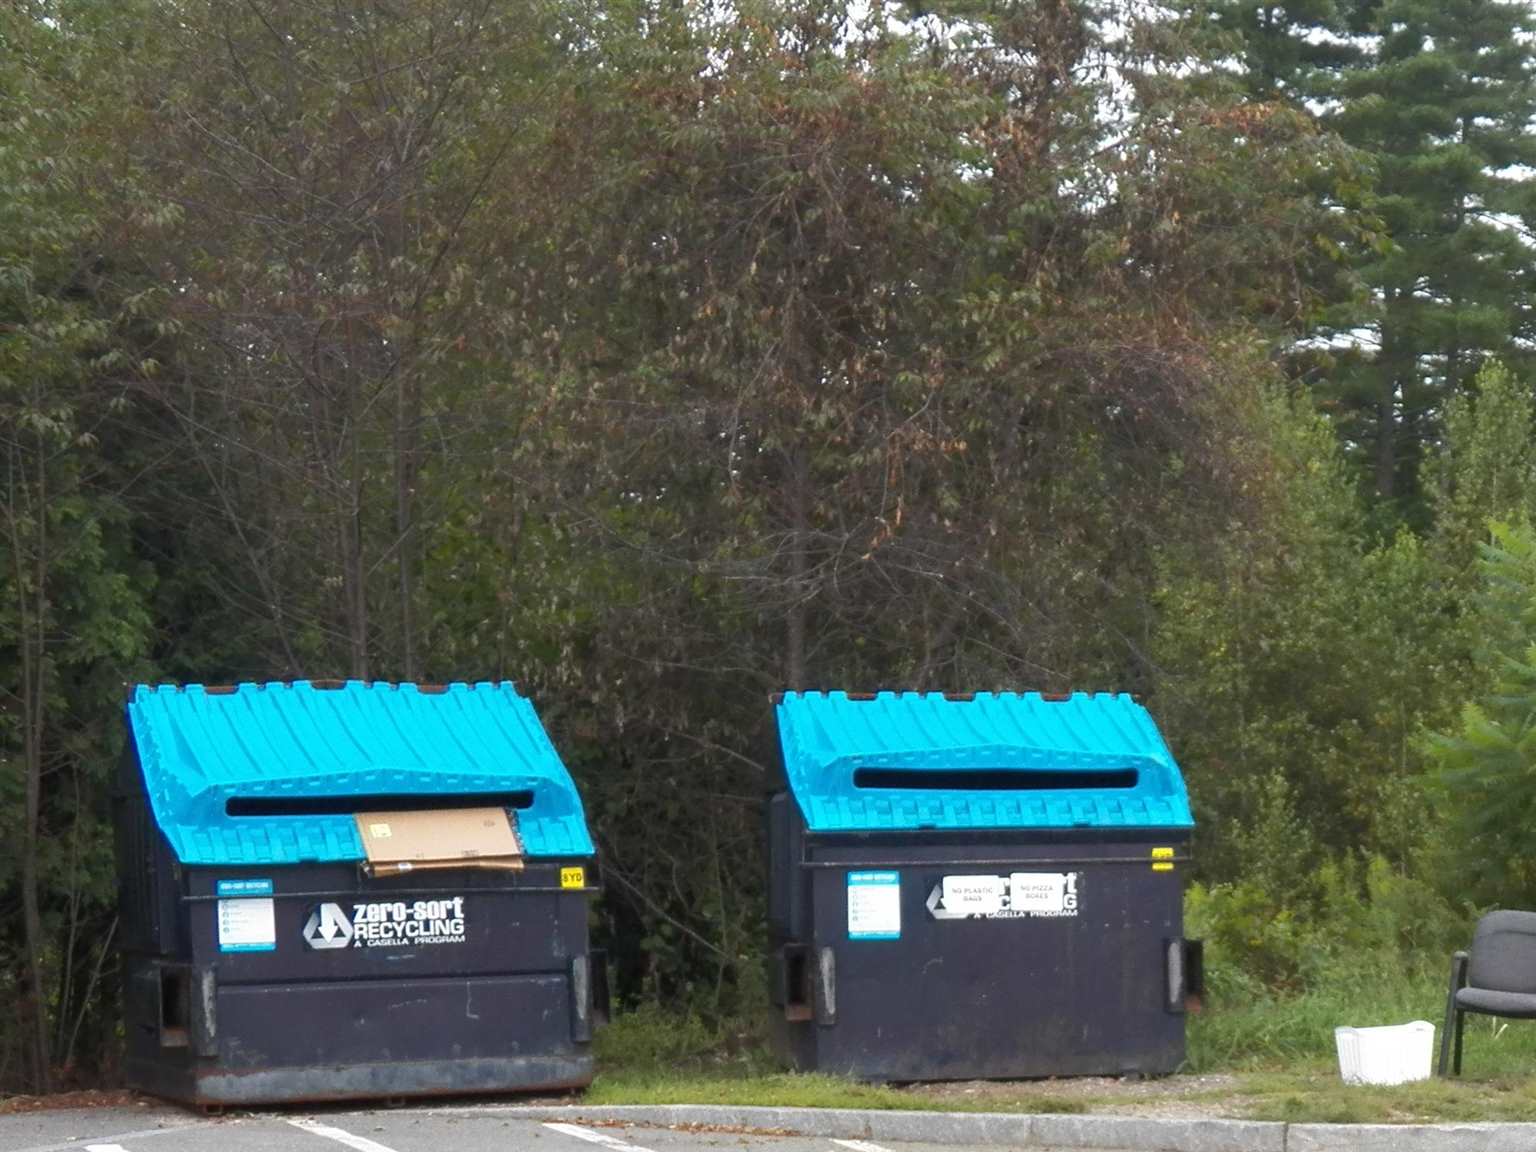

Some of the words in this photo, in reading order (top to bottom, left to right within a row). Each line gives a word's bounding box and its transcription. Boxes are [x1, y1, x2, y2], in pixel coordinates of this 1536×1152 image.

[964, 887, 993, 896] PLASTIC
[1032, 885, 1053, 893] PIZZA
[353, 896, 464, 923] zero-sort
[1030, 908, 1078, 917] PROGRAM
[354, 919, 465, 940] RECYCLING
[353, 940, 362, 948] A
[367, 938, 409, 947] CASELLA
[414, 935, 466, 944] PROGRAM
